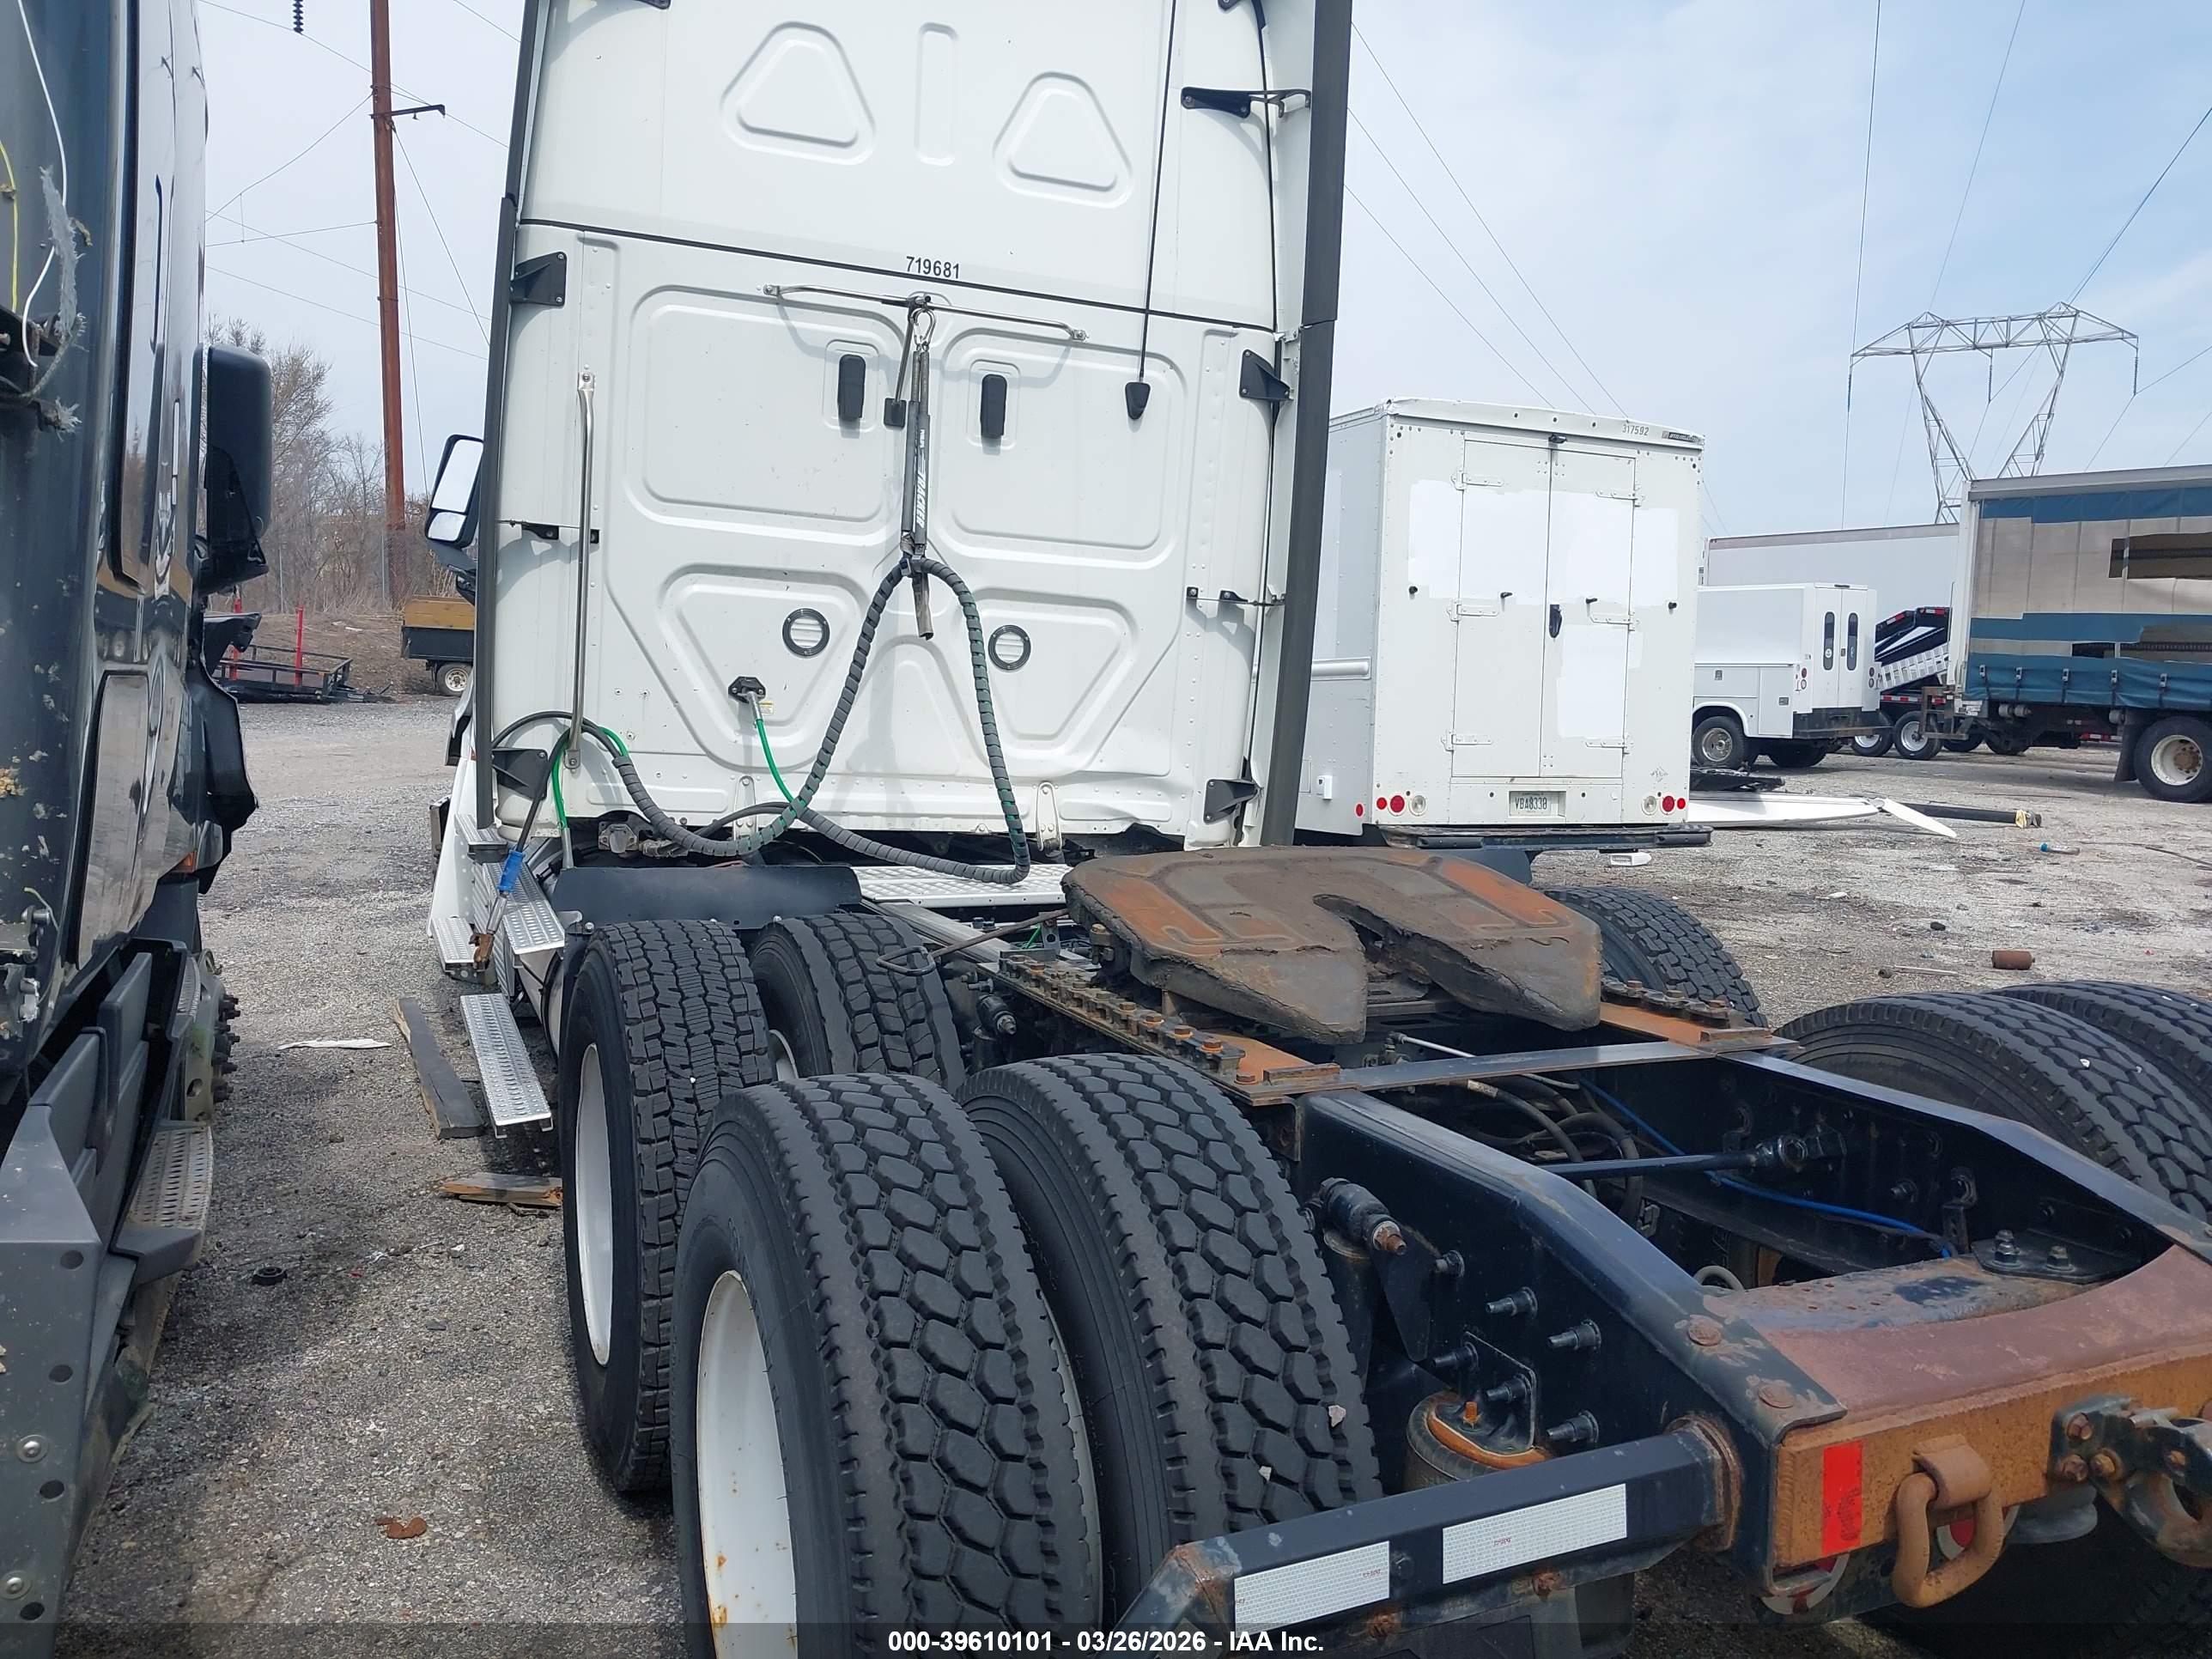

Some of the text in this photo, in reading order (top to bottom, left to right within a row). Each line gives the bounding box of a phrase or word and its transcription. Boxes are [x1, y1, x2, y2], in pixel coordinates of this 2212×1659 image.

[906, 256, 960, 279] 719681
[1622, 423, 1650, 436] 317592
[916, 468, 927, 529] TRACKER
